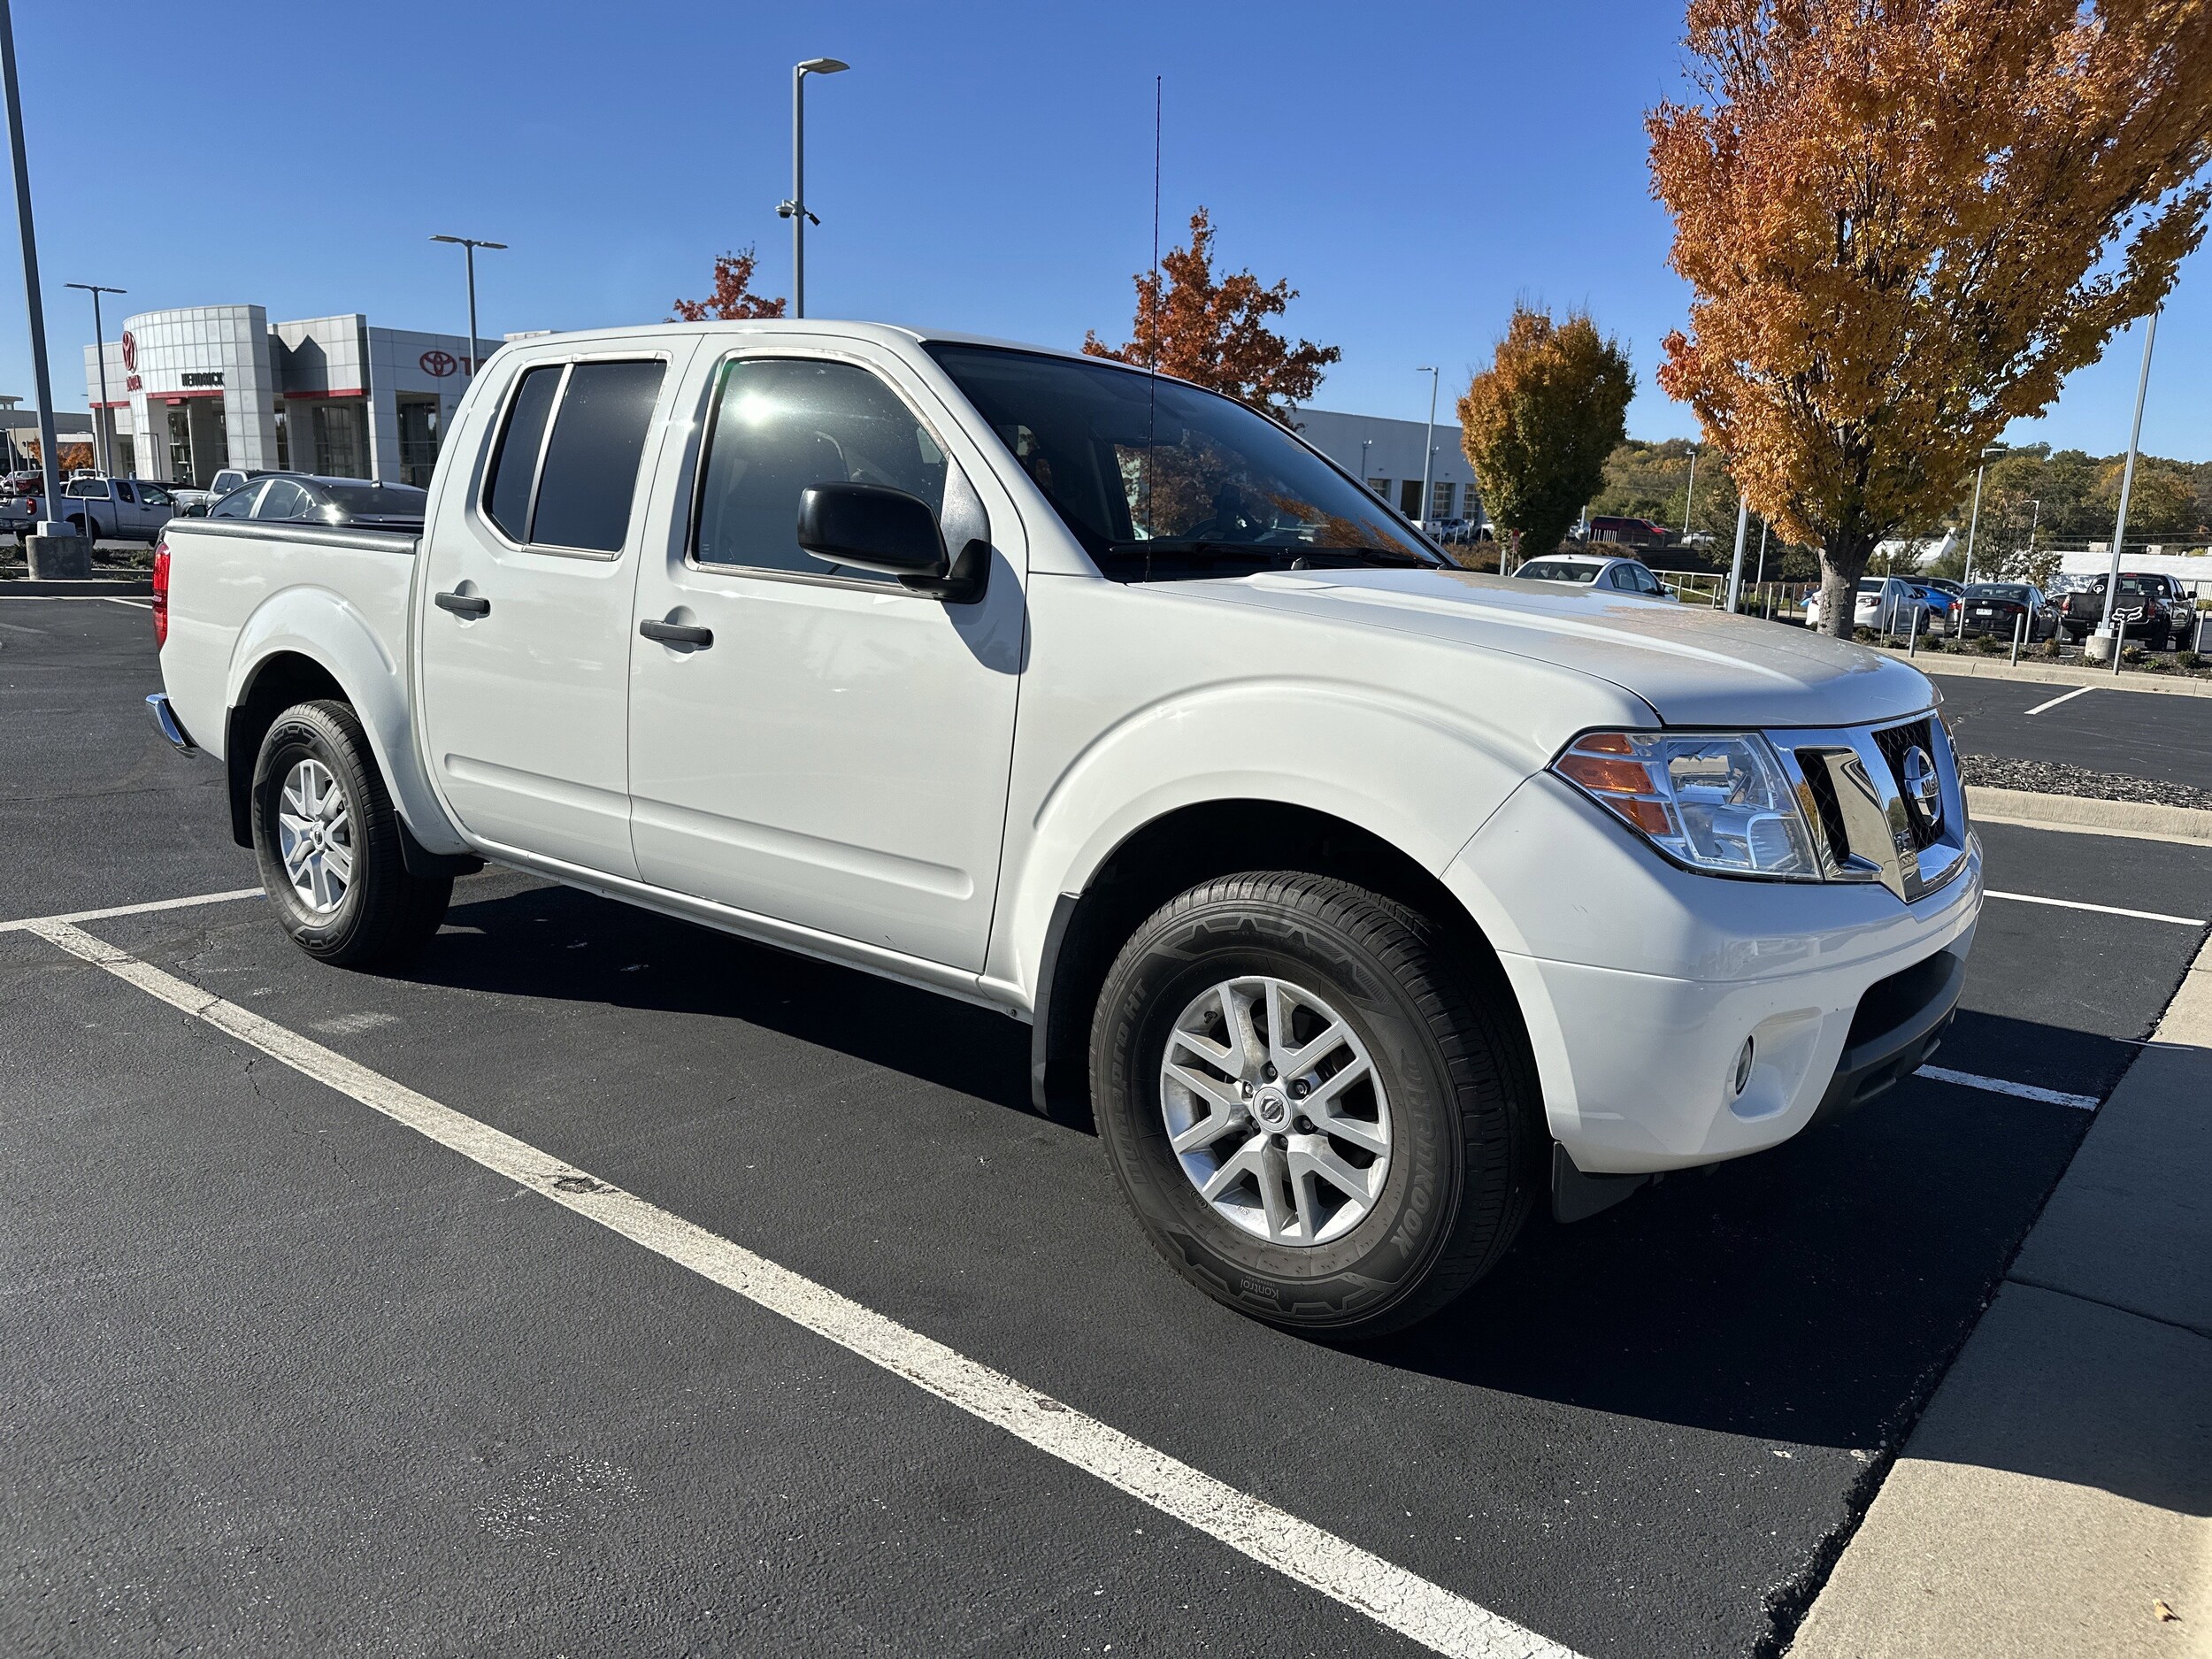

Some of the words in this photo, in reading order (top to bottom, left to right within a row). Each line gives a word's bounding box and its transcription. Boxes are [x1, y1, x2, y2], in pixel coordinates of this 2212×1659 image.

[181, 373, 225, 387] HENDRICK
[1124, 977, 1148, 1021] HT
[1240, 1279, 1279, 1300] Kontrol
